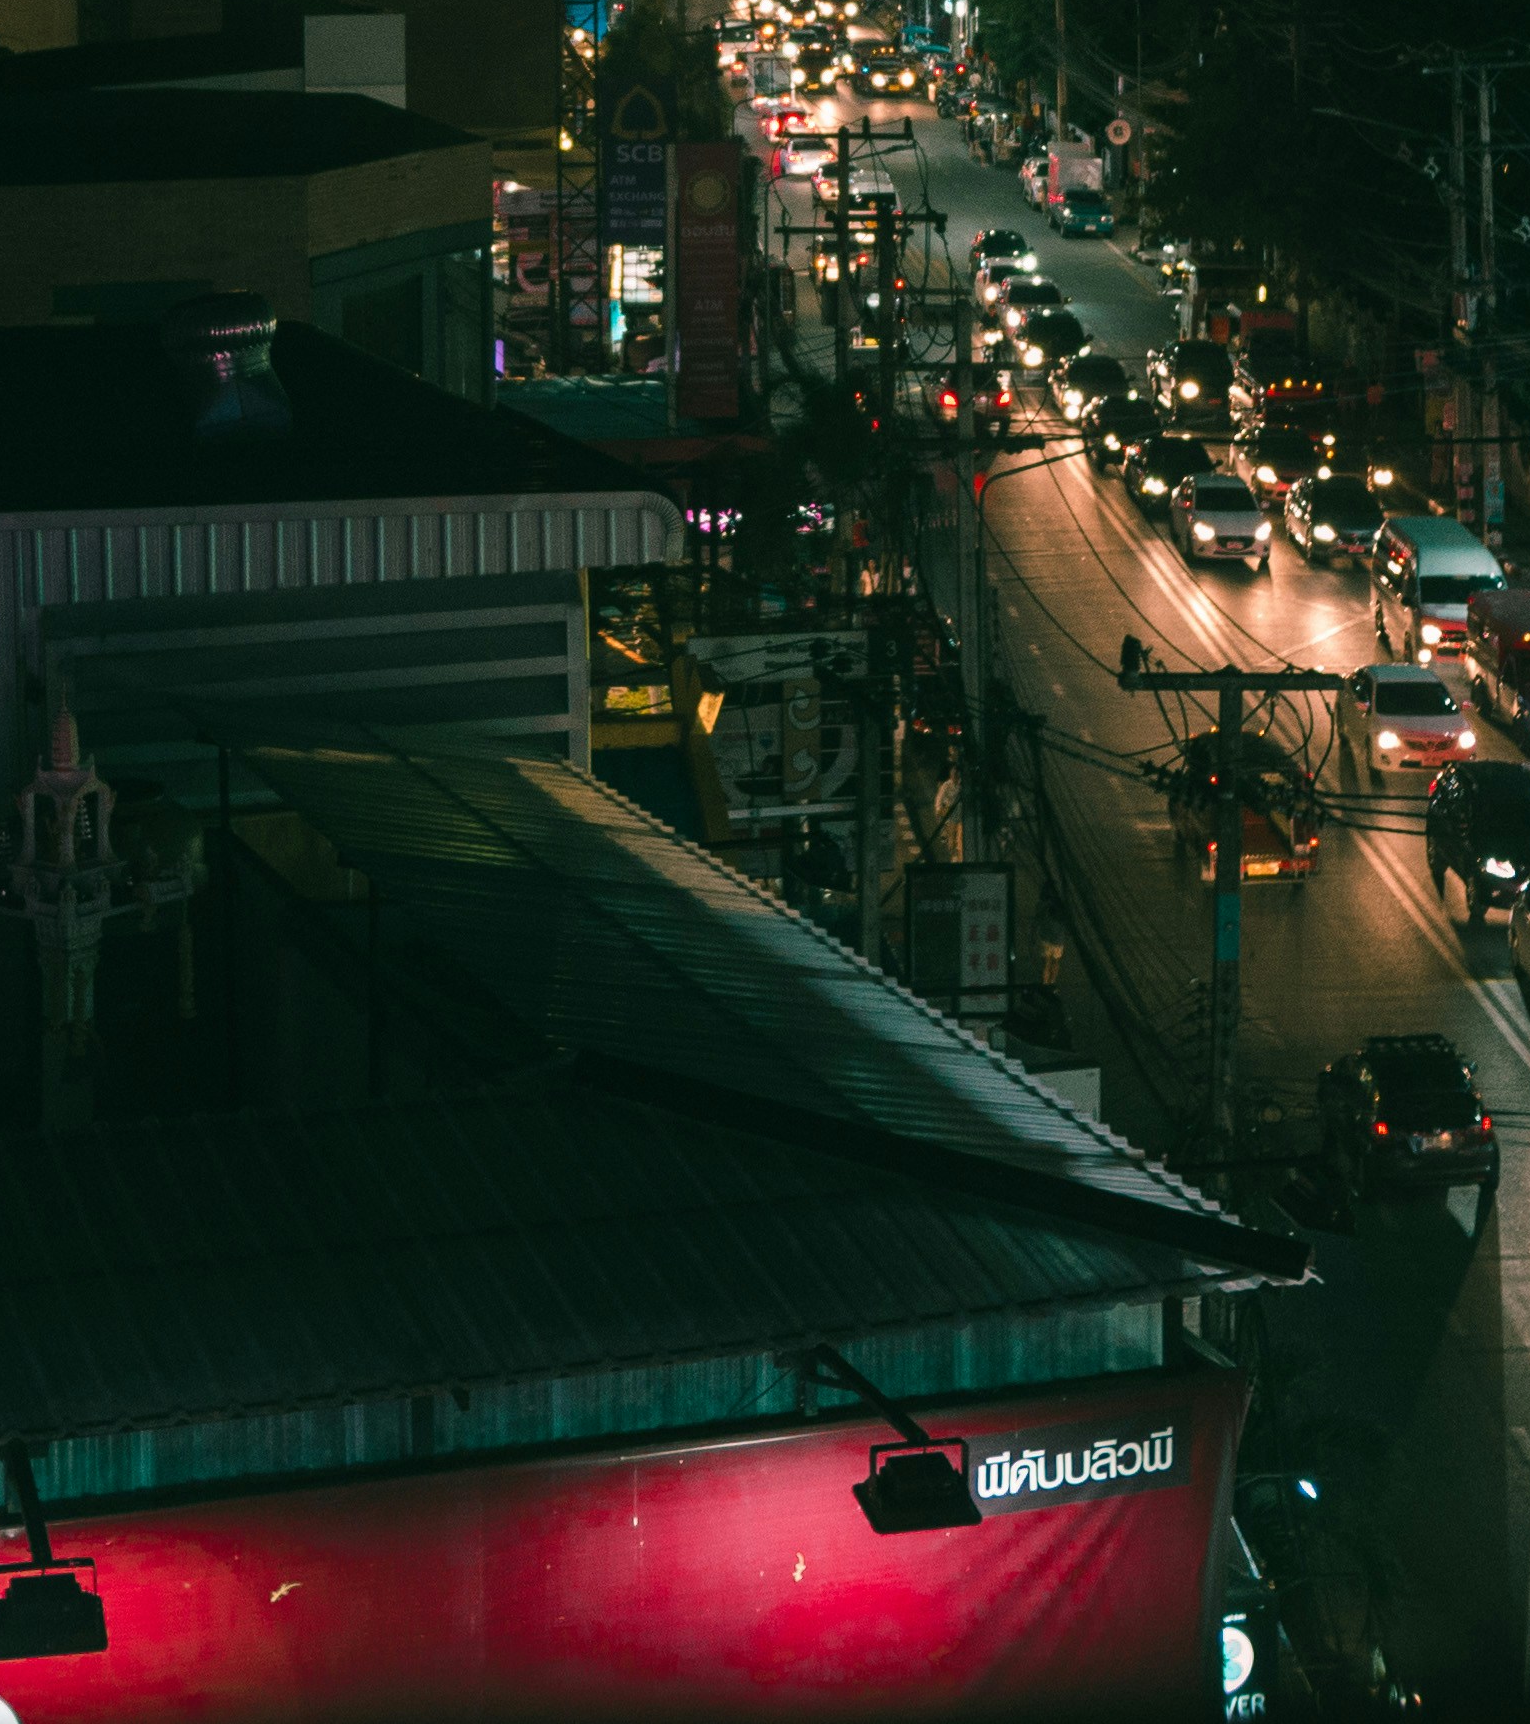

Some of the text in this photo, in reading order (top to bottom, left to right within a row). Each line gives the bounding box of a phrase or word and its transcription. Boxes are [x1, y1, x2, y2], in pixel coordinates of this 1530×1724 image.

[615, 143, 664, 164] SCB
[609, 174, 637, 186] ATM
[609, 191, 666, 202] EXCHANG
[977, 1426, 1174, 1499] พีดับบลิวพี
